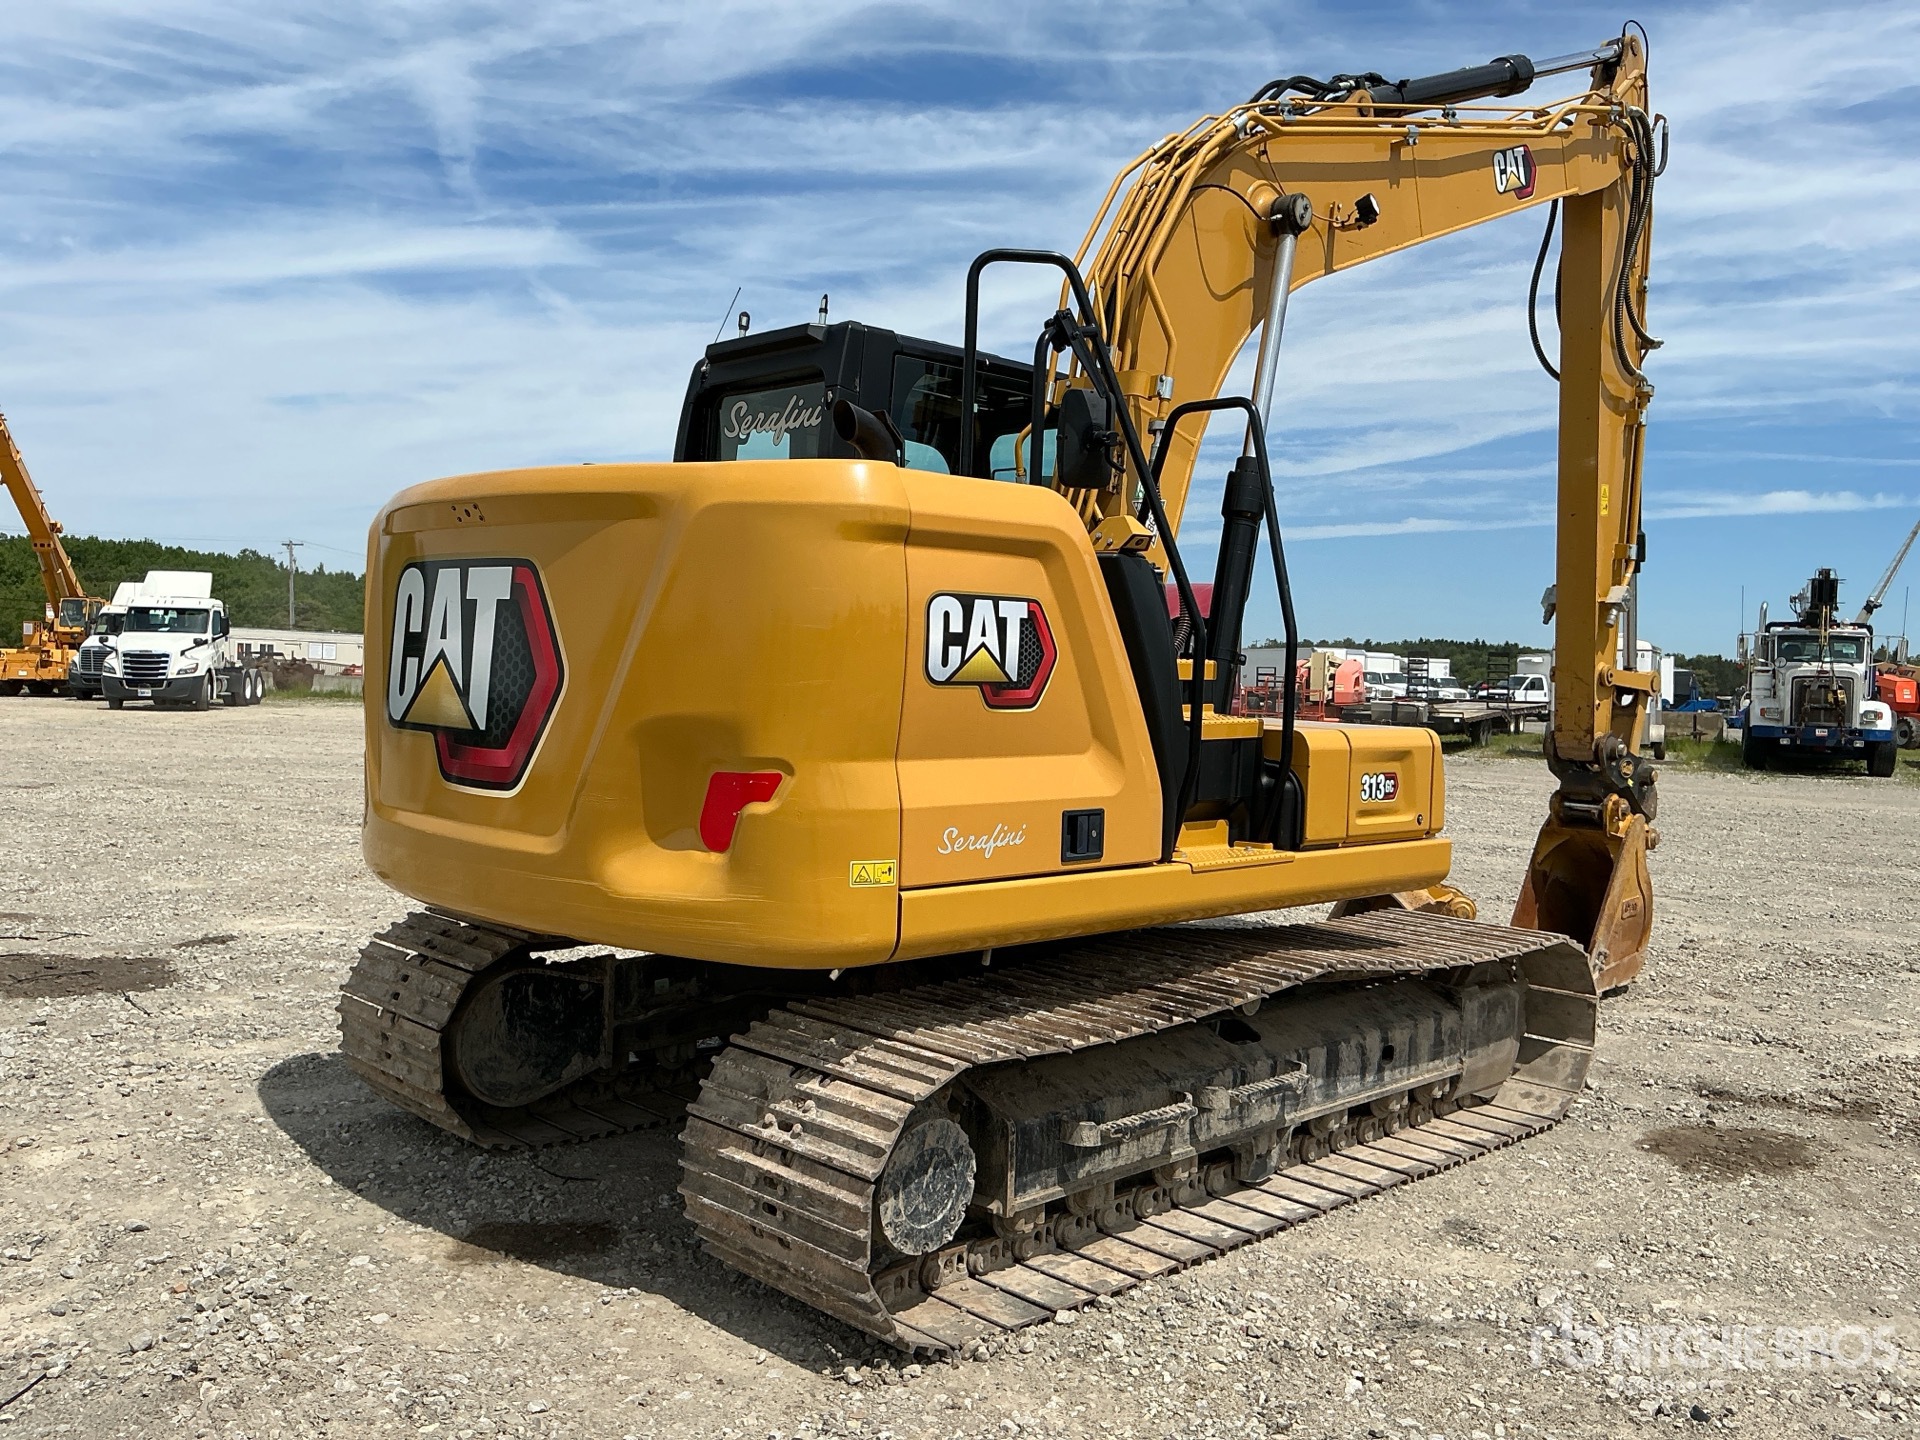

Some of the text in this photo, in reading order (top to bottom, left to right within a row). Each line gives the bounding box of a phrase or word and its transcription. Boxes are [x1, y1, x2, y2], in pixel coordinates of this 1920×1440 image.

[1493, 146, 1526, 193] CAT
[724, 395, 824, 446] Serafini
[388, 566, 513, 731] CAT
[928, 595, 1029, 682] CAT
[1361, 773, 1385, 800] 313
[937, 823, 1027, 859] Serafini
